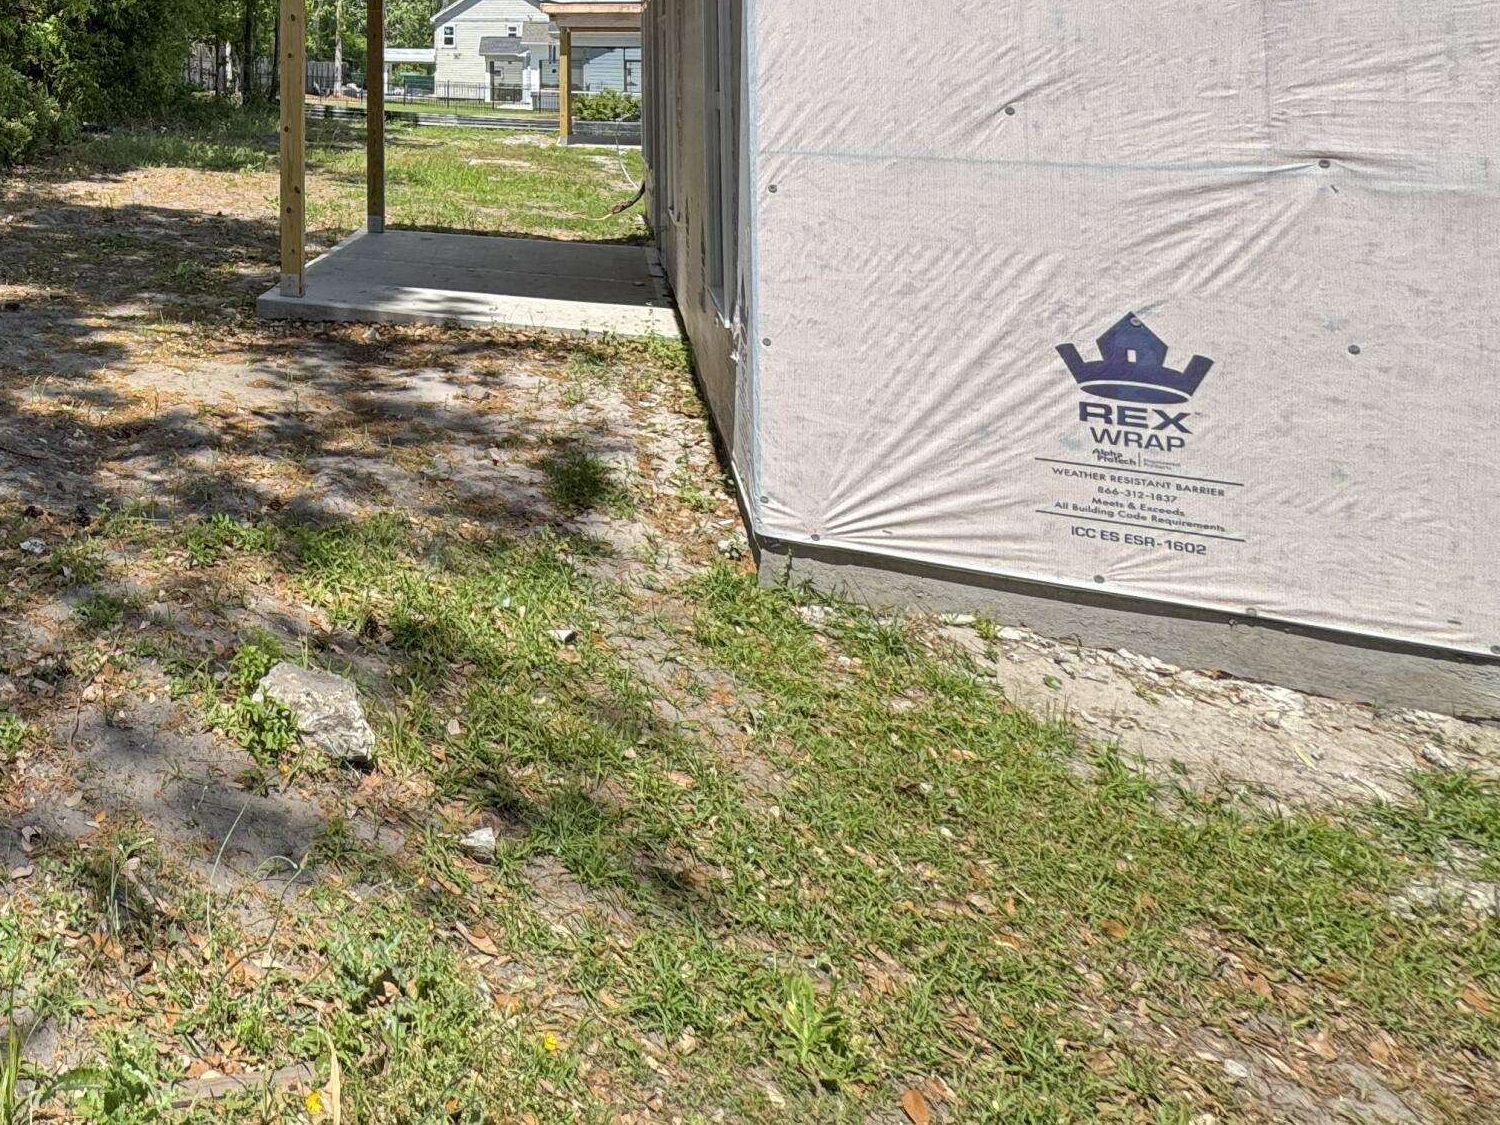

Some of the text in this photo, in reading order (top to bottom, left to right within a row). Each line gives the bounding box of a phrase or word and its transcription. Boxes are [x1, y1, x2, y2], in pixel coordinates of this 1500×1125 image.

[1079, 401, 1193, 434] REX
[1090, 427, 1185, 452] WRAP
[1052, 466, 1225, 497] WEATHER RESISTANT BARRIER
[1098, 486, 1178, 503] 866-312-1837
[1054, 501, 1226, 533] All Building Code Requirements
[1092, 497, 1185, 517] Meets & Exceeds
[1071, 526, 1207, 555] ICC ES ESR-1602
